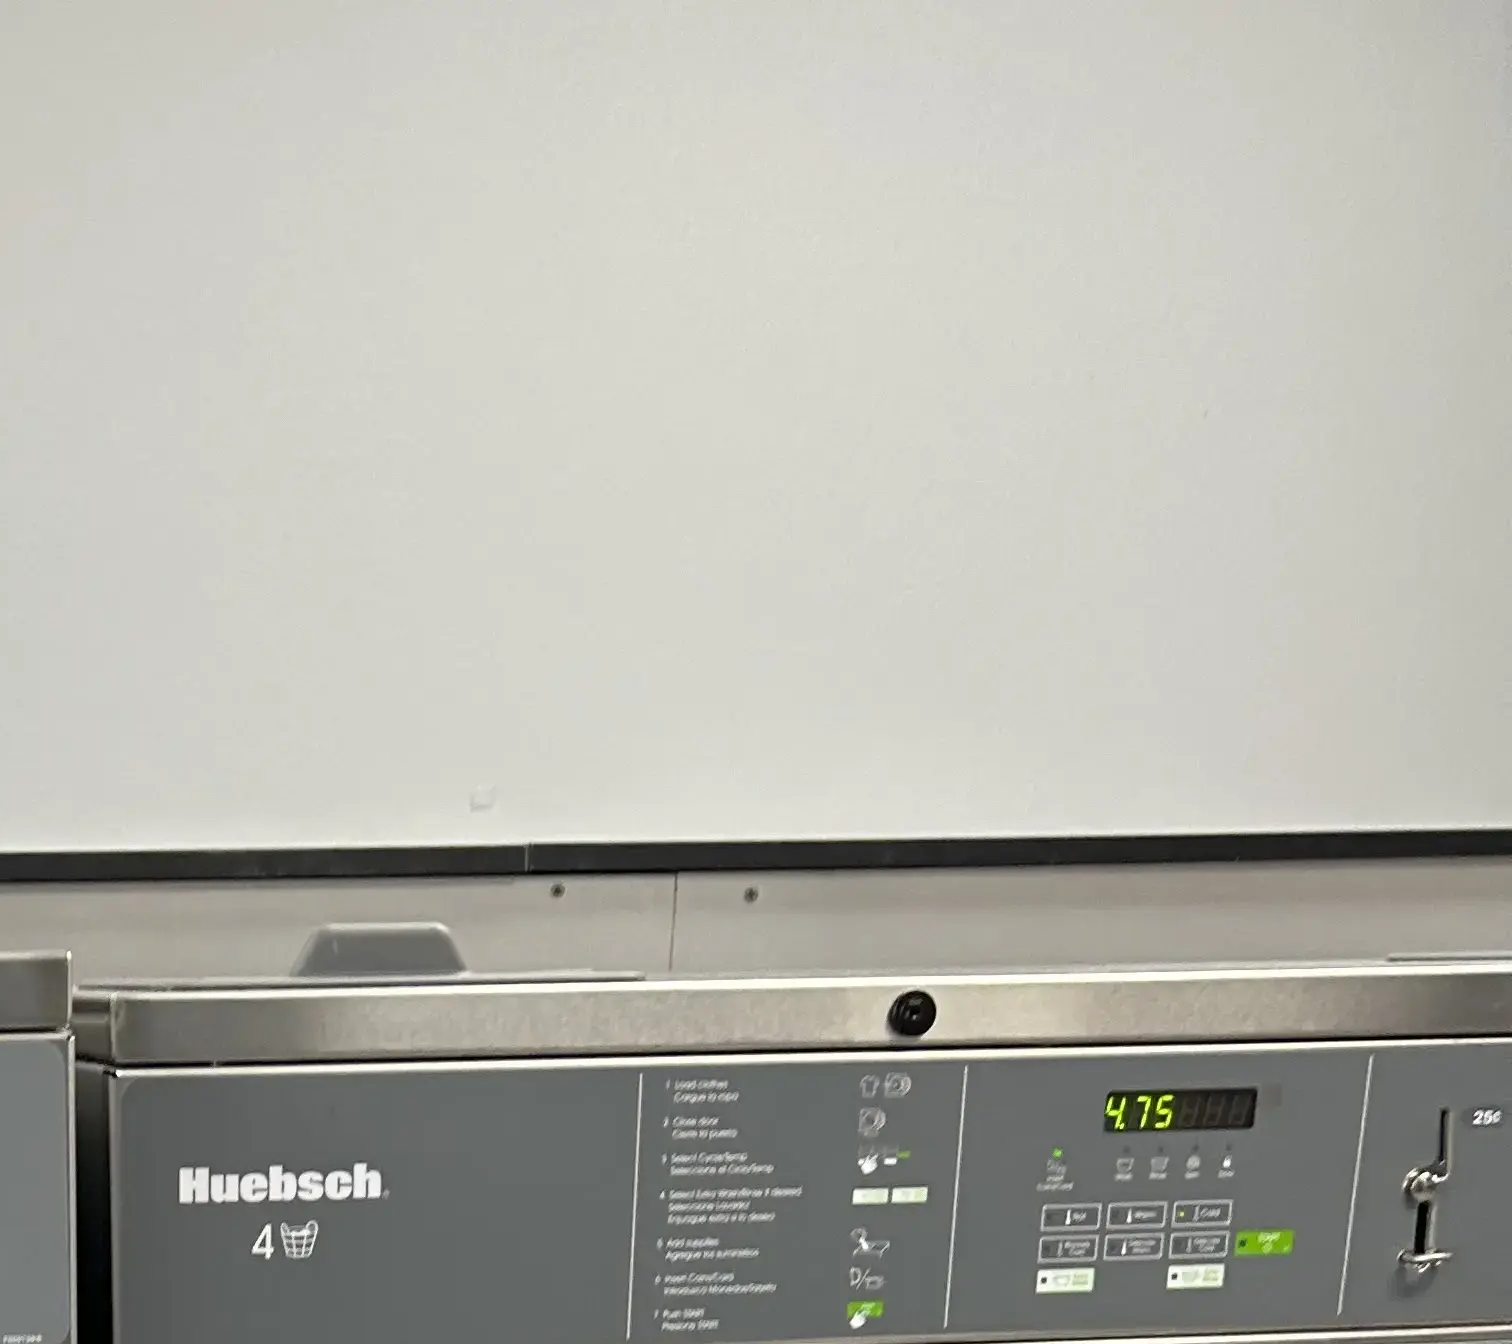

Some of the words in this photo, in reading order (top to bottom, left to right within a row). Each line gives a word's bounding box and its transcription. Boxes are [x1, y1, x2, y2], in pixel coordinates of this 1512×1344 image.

[1105, 1094, 1175, 1130] 4.75
[178, 1162, 383, 1204] Huebsch
[250, 1223, 275, 1260] 4
